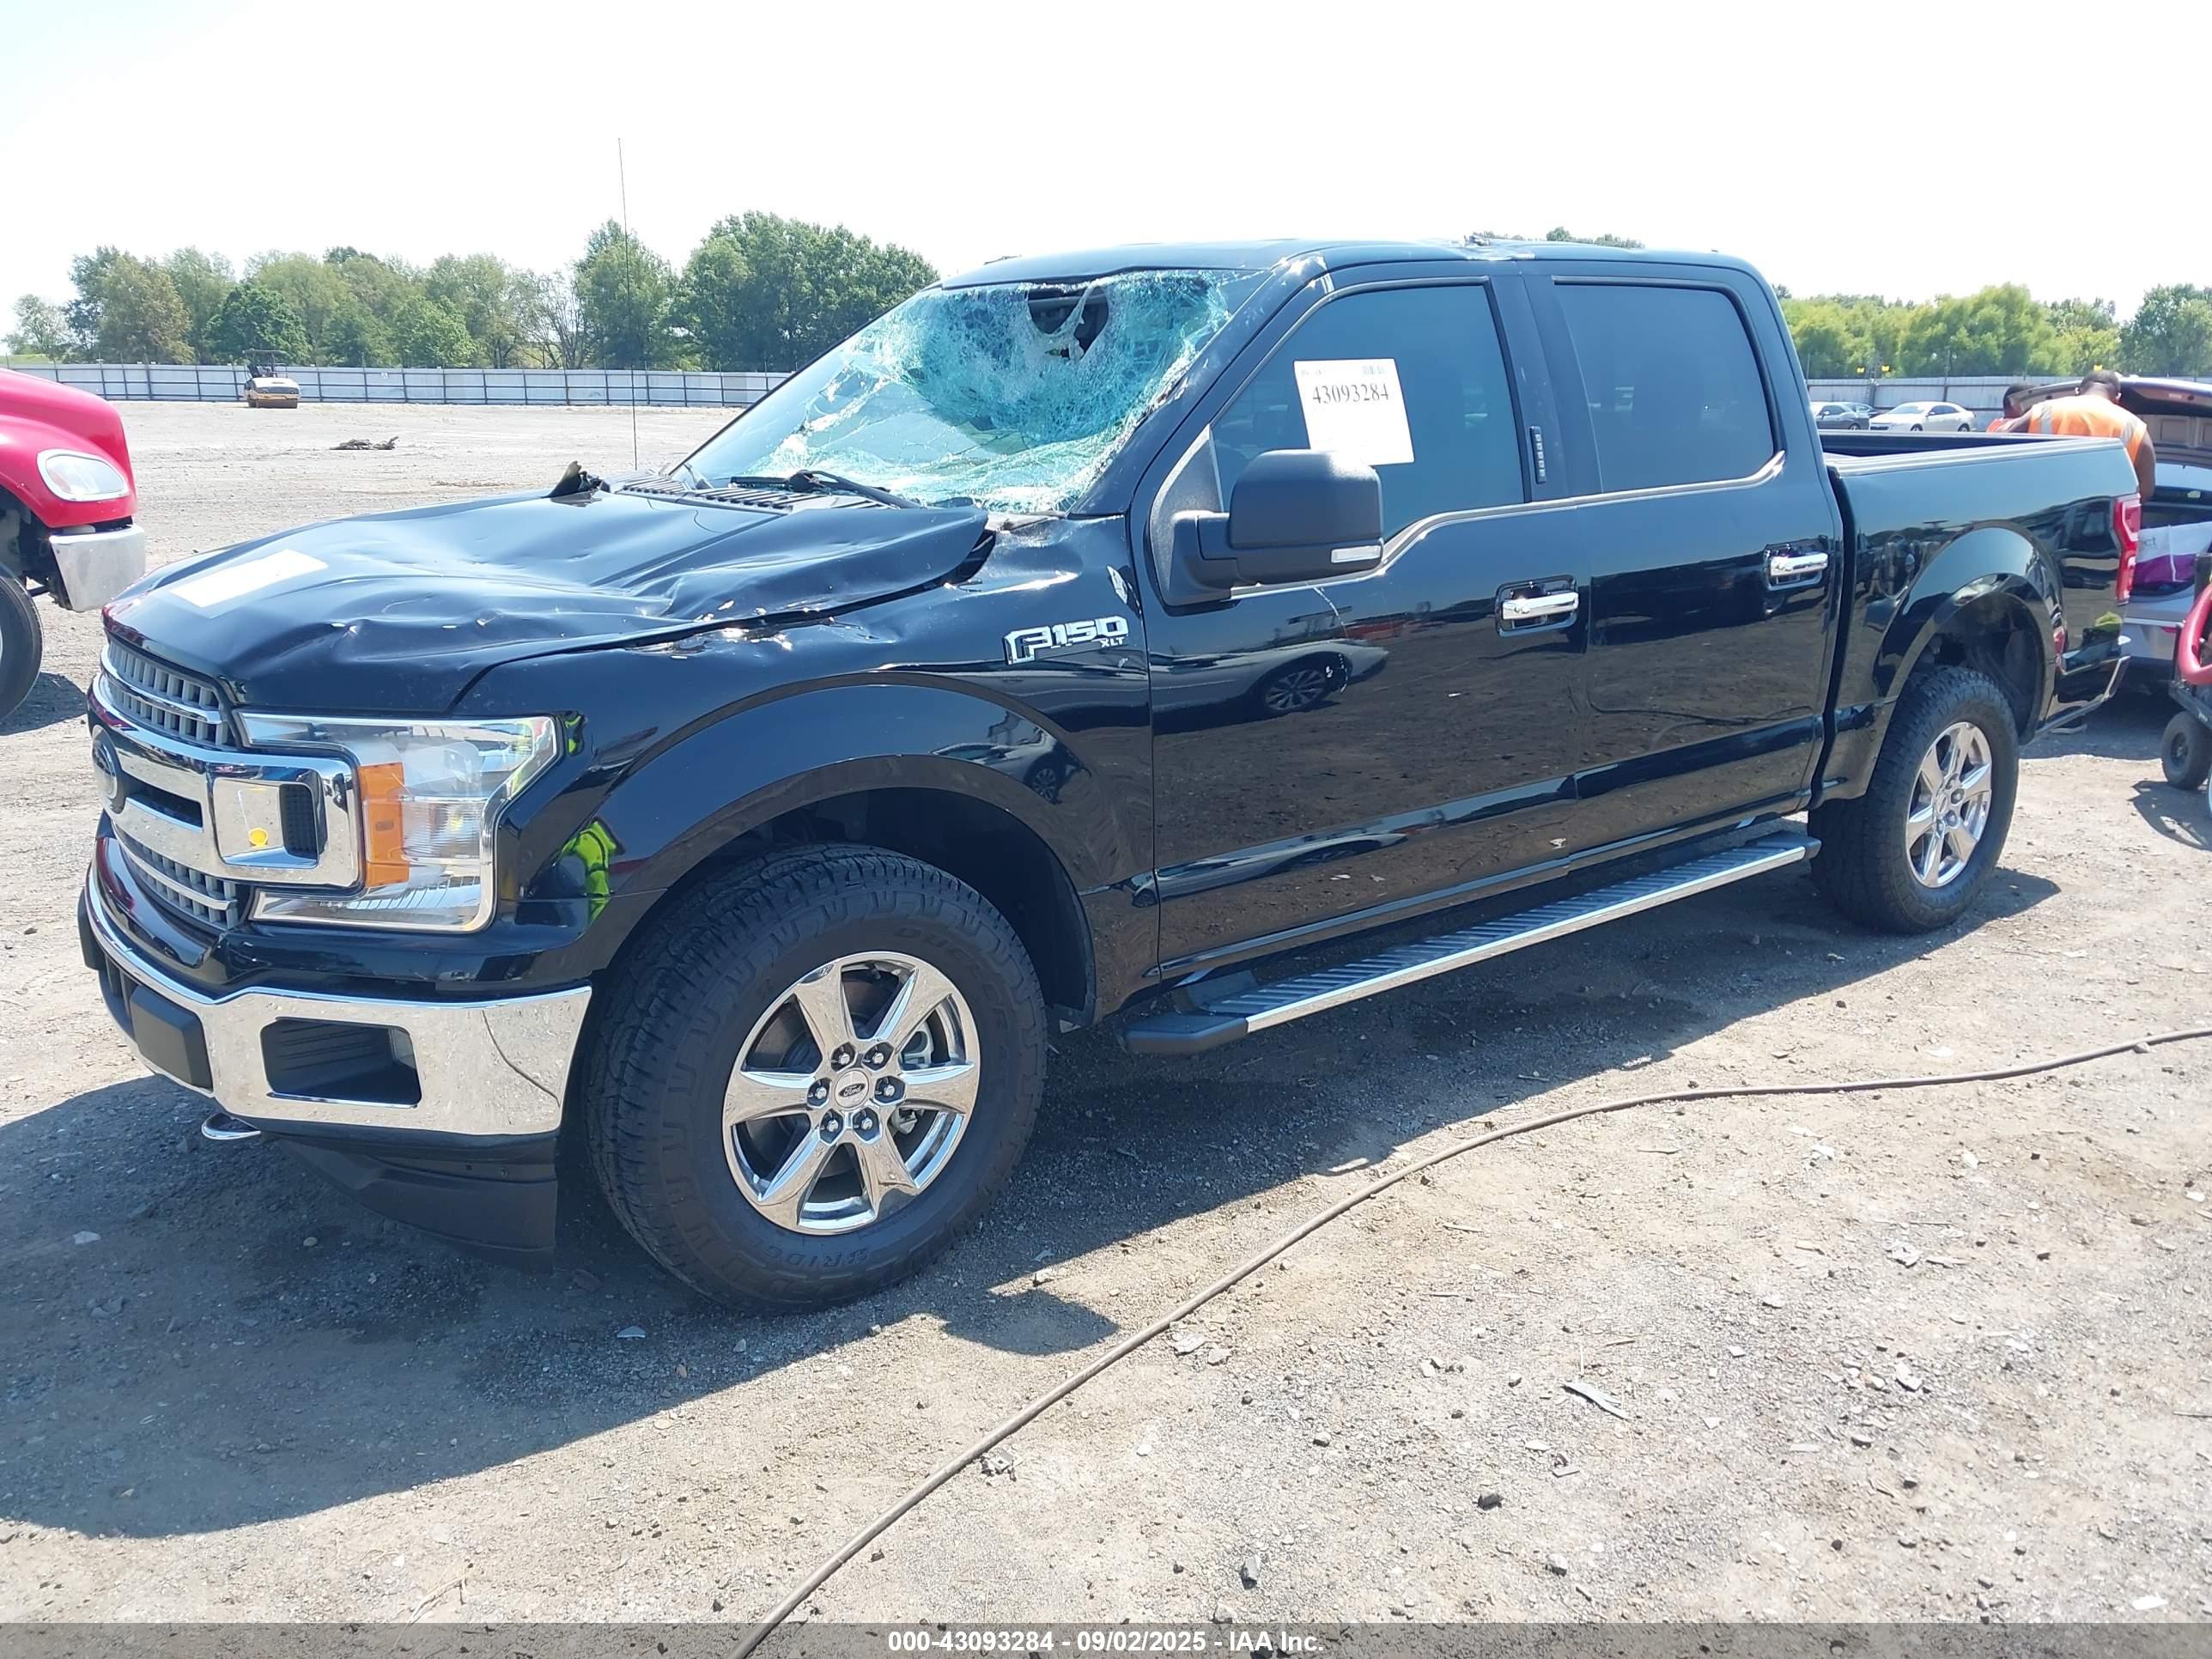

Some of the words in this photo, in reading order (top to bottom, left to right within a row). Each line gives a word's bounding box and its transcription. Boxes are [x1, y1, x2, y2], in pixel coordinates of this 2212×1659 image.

[1312, 382, 1389, 404] 43093284
[1100, 636, 1126, 647] XLT
[842, 1084, 862, 1097] Ford
